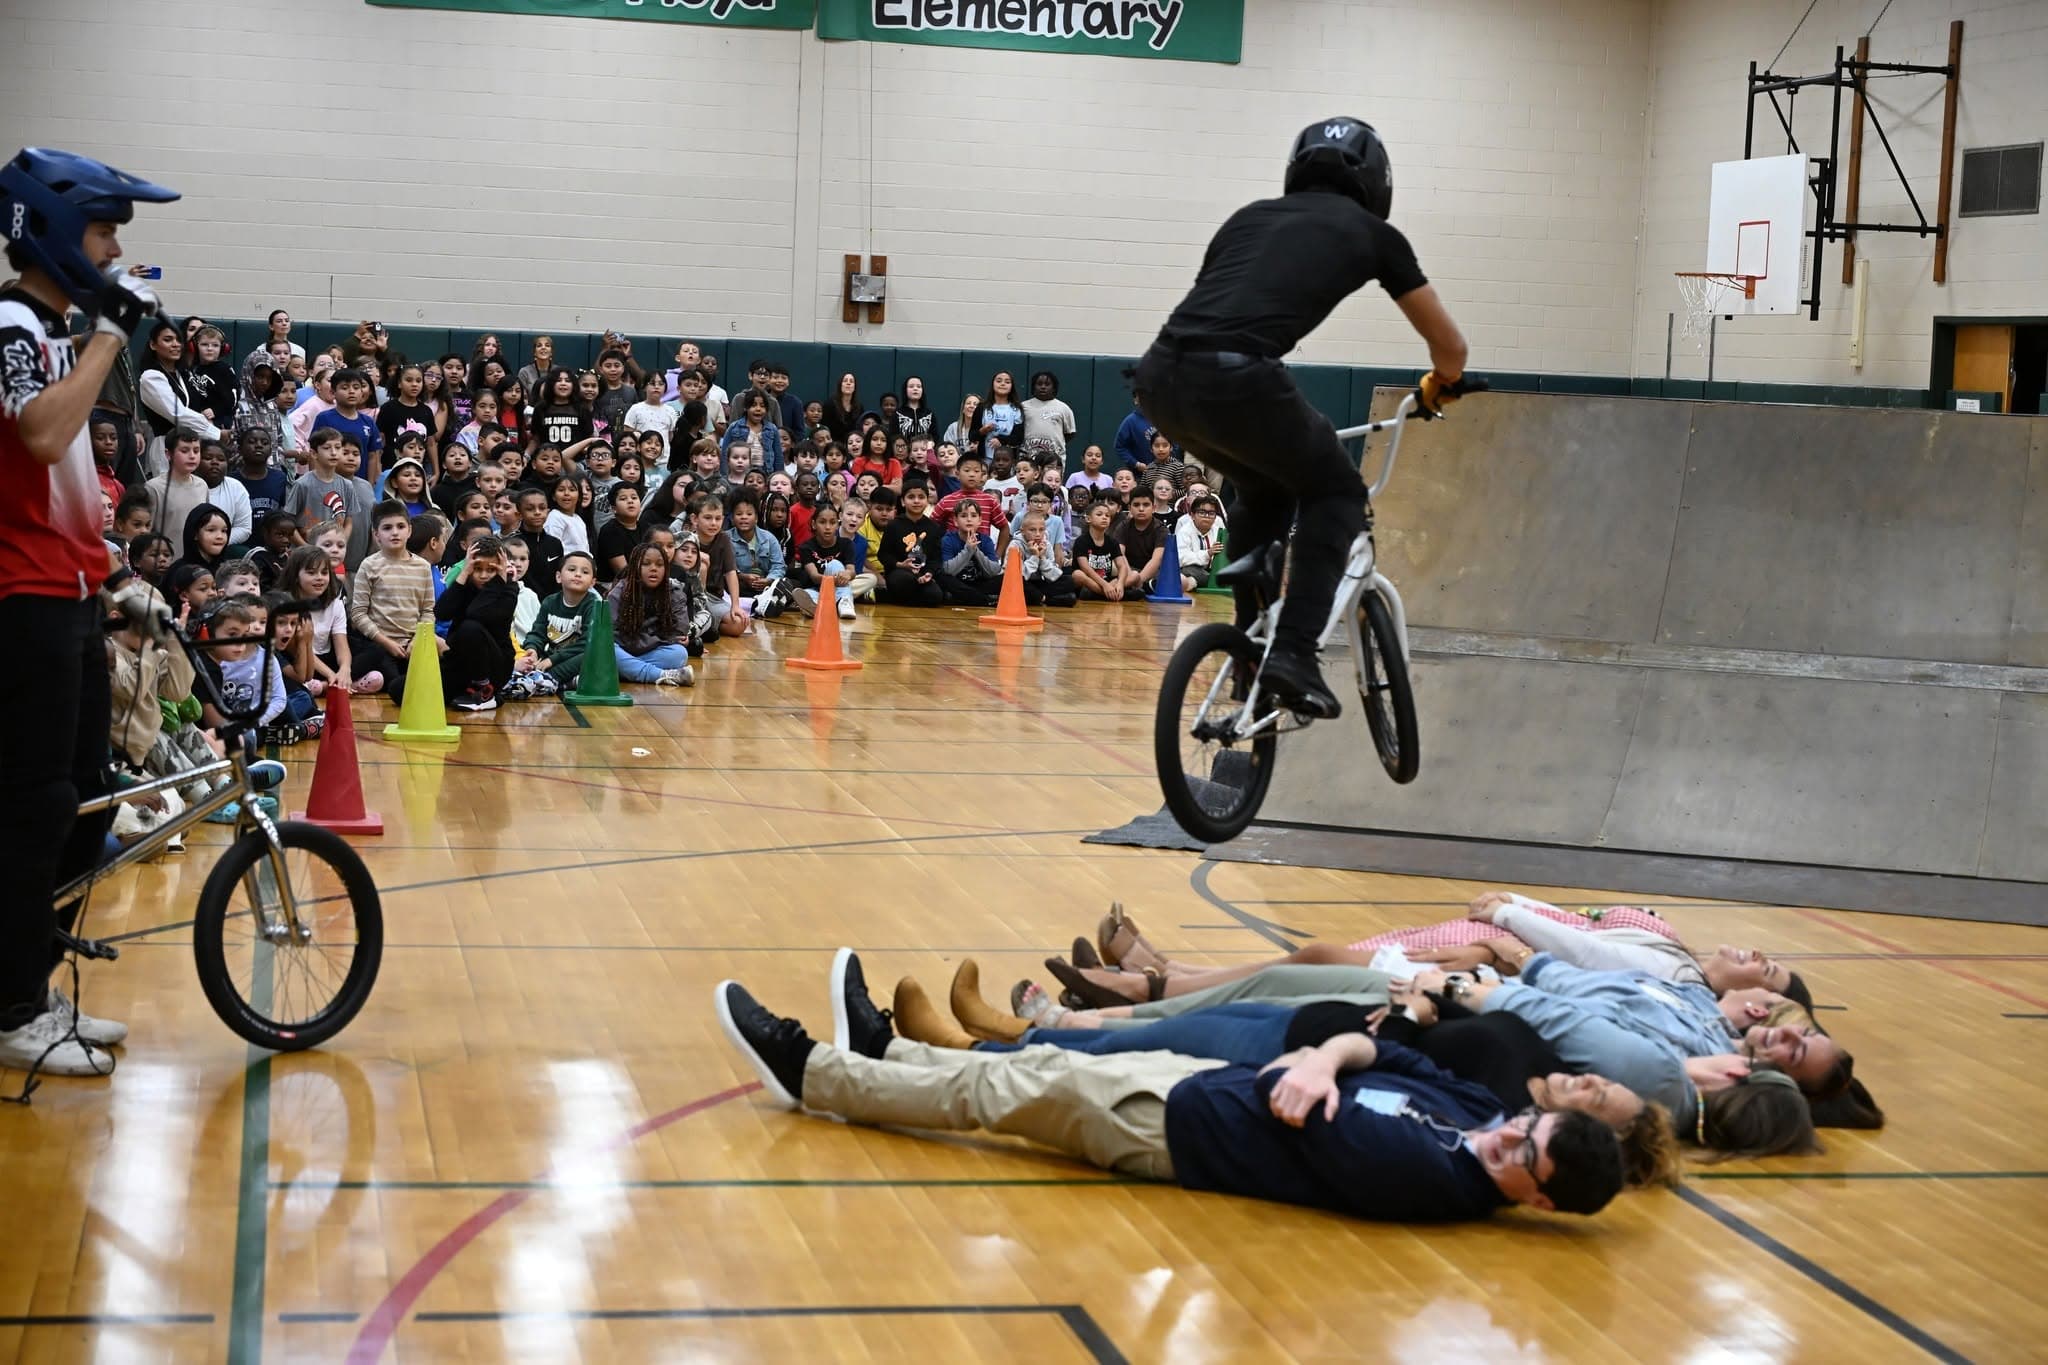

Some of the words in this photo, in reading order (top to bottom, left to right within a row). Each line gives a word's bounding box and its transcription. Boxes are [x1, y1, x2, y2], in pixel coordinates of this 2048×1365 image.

[873, 0, 1183, 49] Elementary
[11, 203, 24, 239] POC
[731, 321, 737, 331] E
[549, 425, 571, 443] 00
